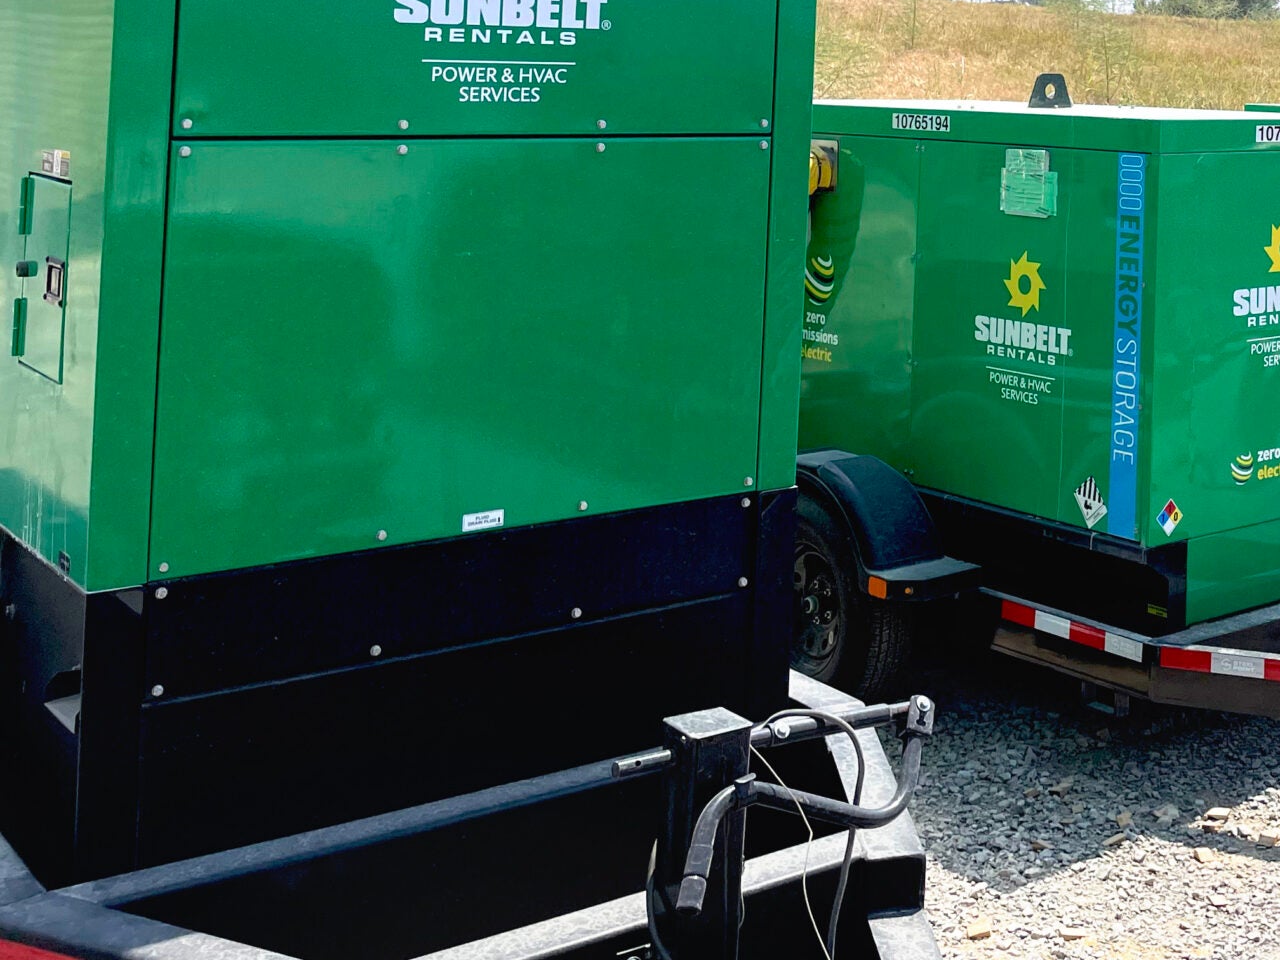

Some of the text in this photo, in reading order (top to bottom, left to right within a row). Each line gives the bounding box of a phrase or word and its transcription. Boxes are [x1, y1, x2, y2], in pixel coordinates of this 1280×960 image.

[424, 27, 576, 45] RENTALS
[431, 67, 567, 84] POWER & HVAC
[459, 87, 540, 102] SERVICES
[894, 114, 949, 130] 10765194
[1118, 215, 1140, 337] ENERGY
[806, 311, 825, 325] zero
[975, 315, 1072, 355] SUNBELT
[987, 345, 1055, 365] RENTALS
[989, 372, 1051, 393] POWER & HVAC
[1001, 388, 1038, 405] SERVICES
[1113, 338, 1137, 465] STORAGE
[1257, 447, 1280, 462] zero
